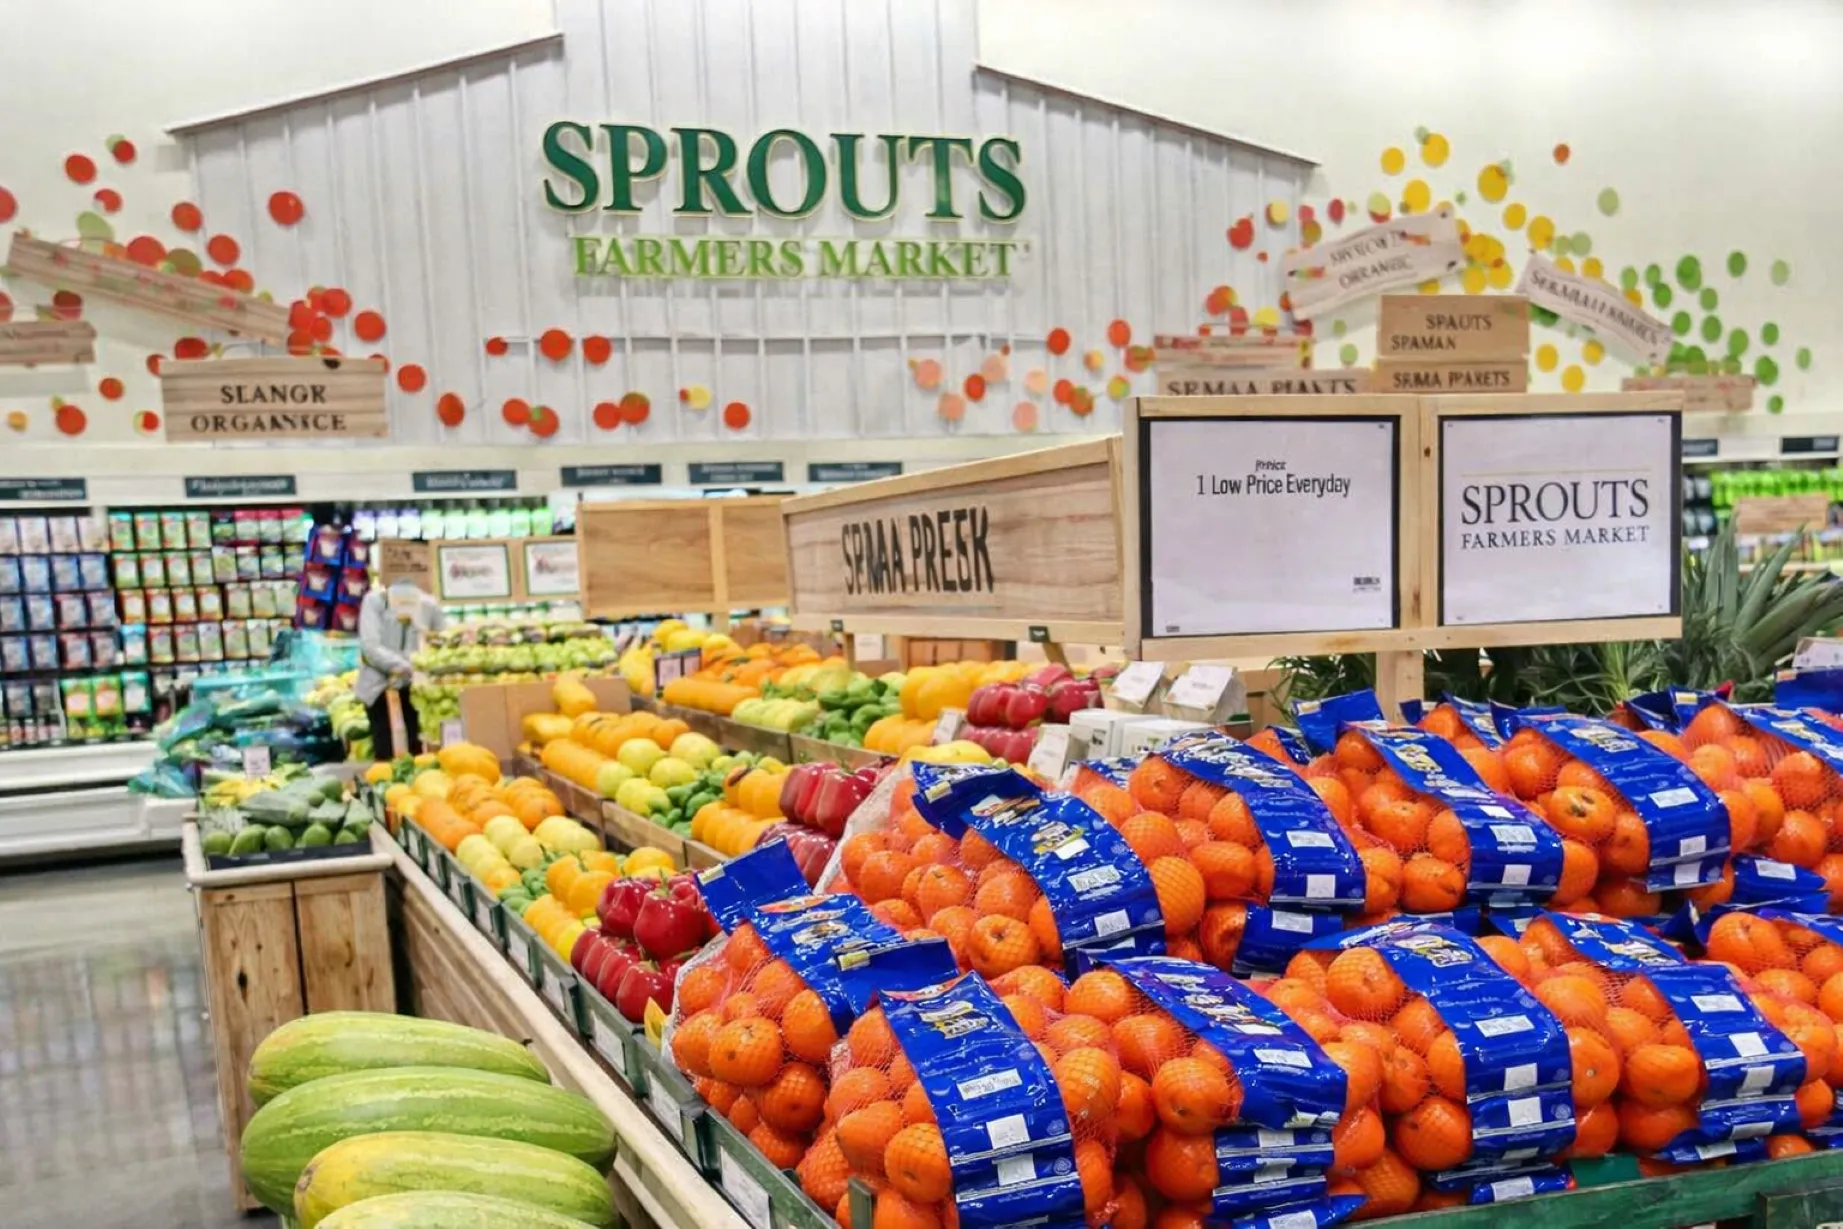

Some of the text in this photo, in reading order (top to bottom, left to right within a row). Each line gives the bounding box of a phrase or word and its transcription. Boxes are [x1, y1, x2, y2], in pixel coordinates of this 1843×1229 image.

[543, 120, 1027, 223] SPROUTS
[573, 236, 1017, 277] FARMERS MARKET
[1197, 473, 1351, 498] 1 Low Price Everyday
[1461, 478, 1649, 525] SPROUTS
[1461, 526, 1650, 549] FARMERS MARKET
